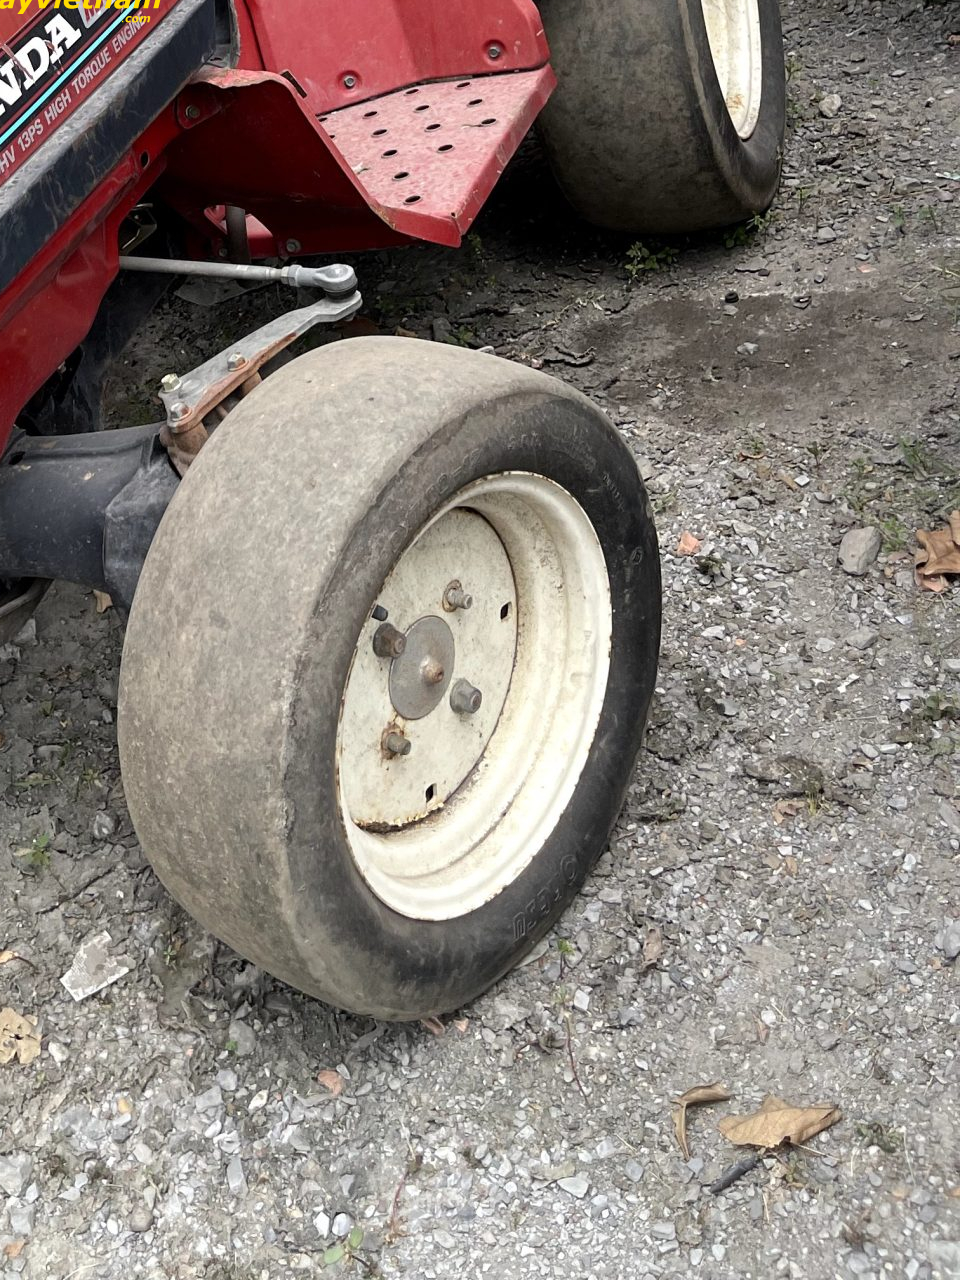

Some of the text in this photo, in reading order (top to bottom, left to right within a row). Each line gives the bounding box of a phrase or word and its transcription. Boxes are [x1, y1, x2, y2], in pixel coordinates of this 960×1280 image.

[17, 118, 44, 154] 13PS
[45, 88, 72, 123] HIGH
[72, 47, 112, 92] TORQUE
[113, 11, 146, 55] ENGINE
